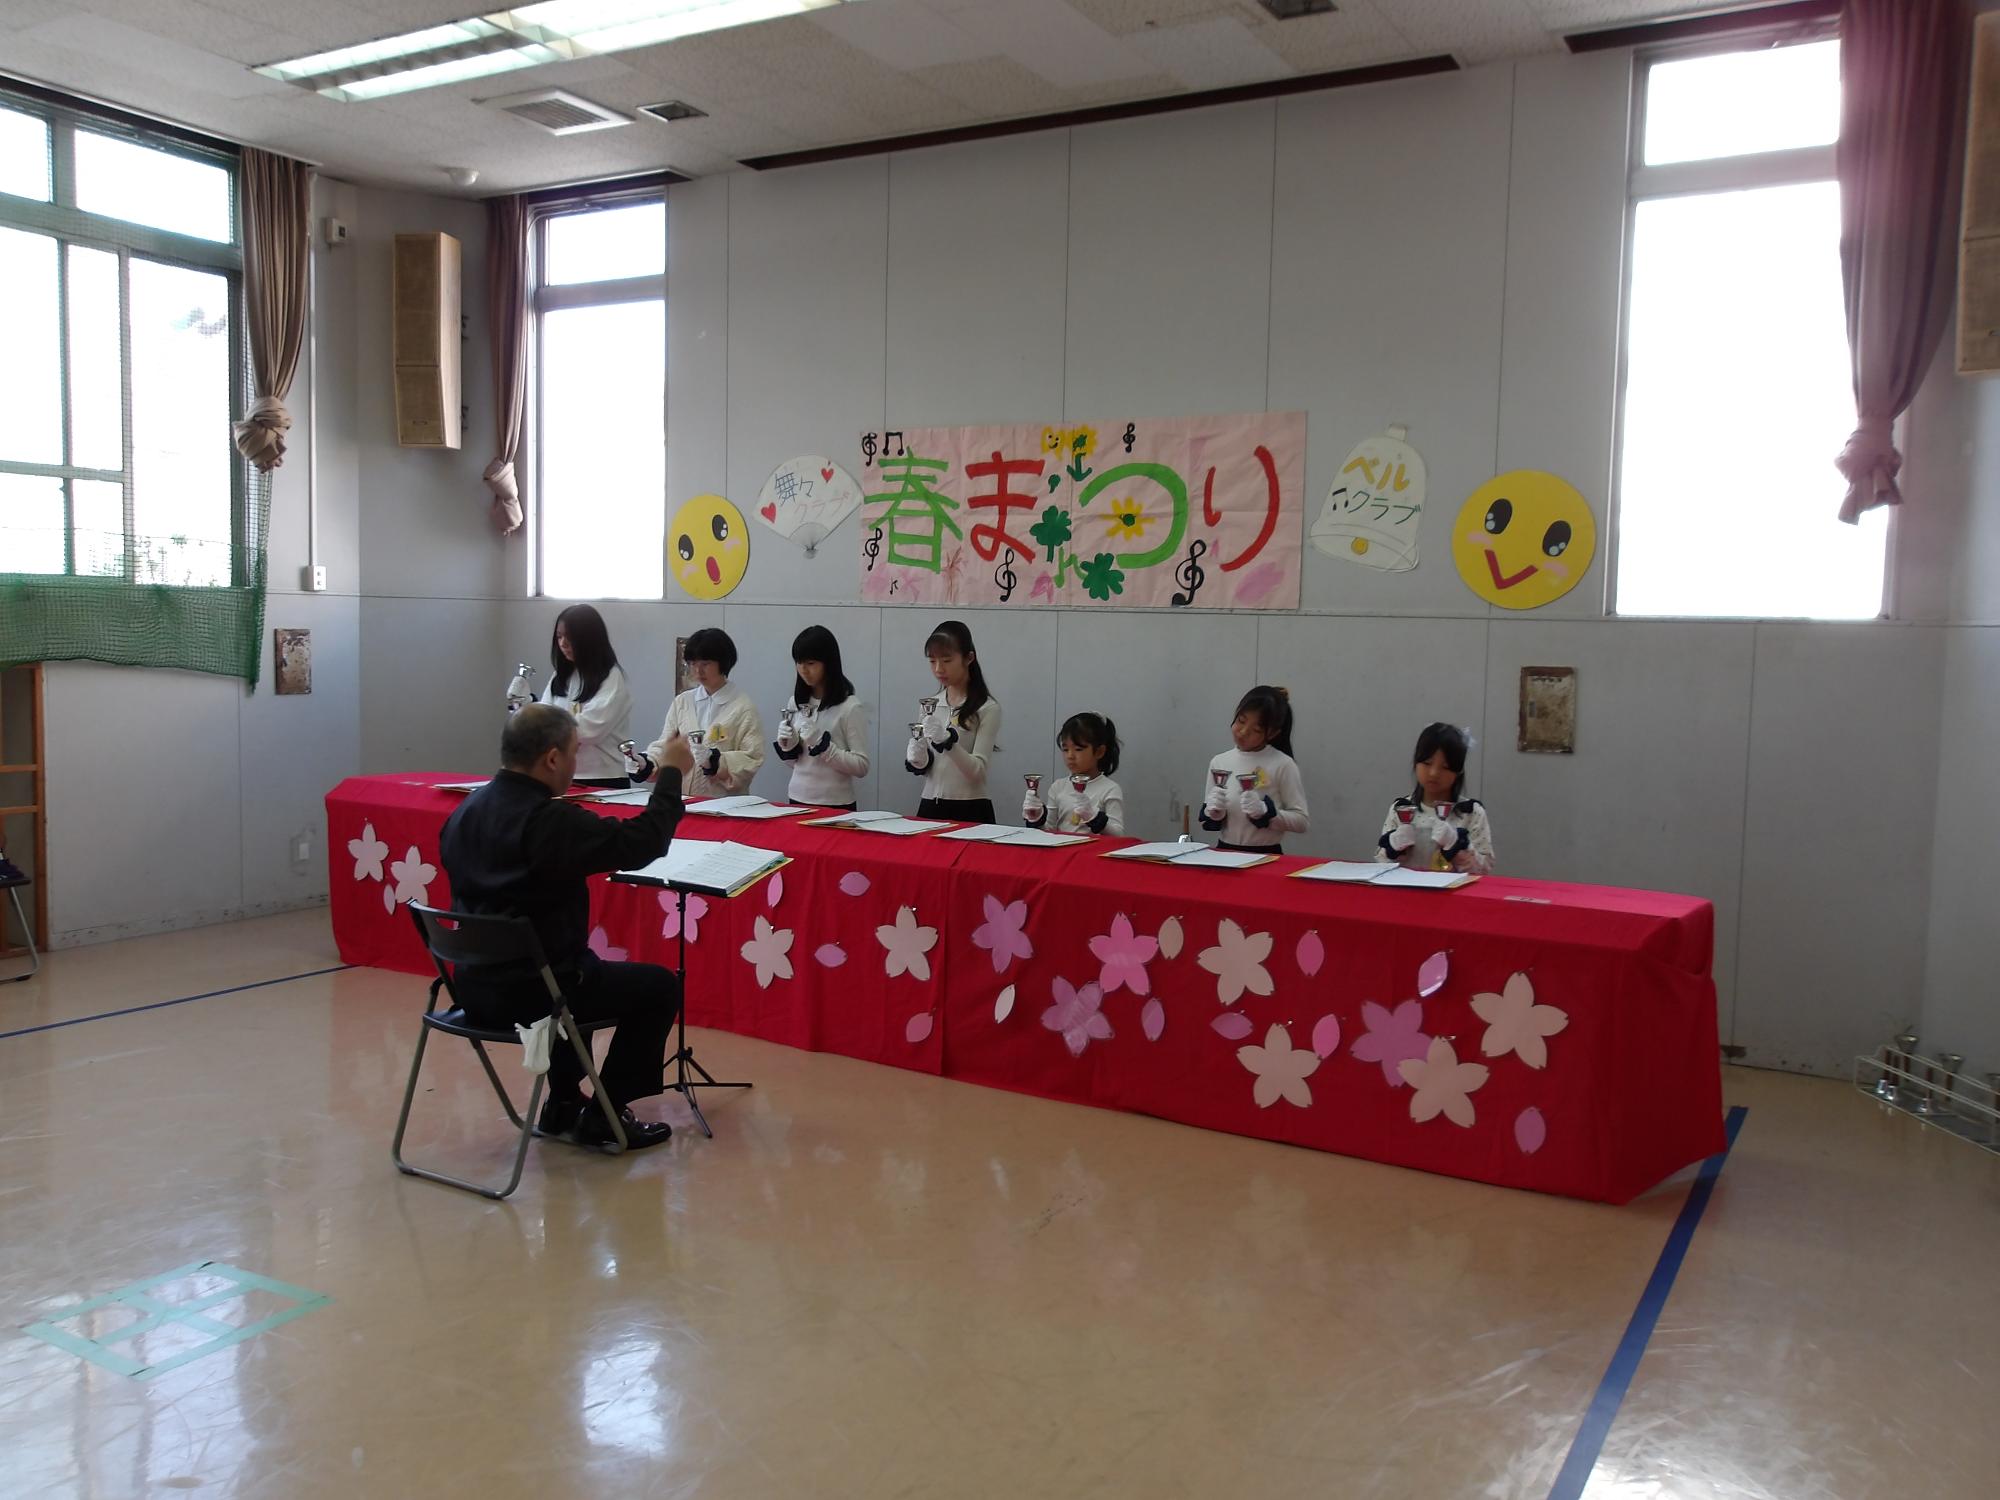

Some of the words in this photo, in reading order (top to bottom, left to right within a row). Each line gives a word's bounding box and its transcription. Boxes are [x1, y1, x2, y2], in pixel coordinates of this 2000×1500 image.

[1343, 456, 1409, 492] ベル
[794, 491, 850, 522] クラブ
[863, 445, 1280, 574] 春まつり
[1347, 490, 1421, 525] クラブ
